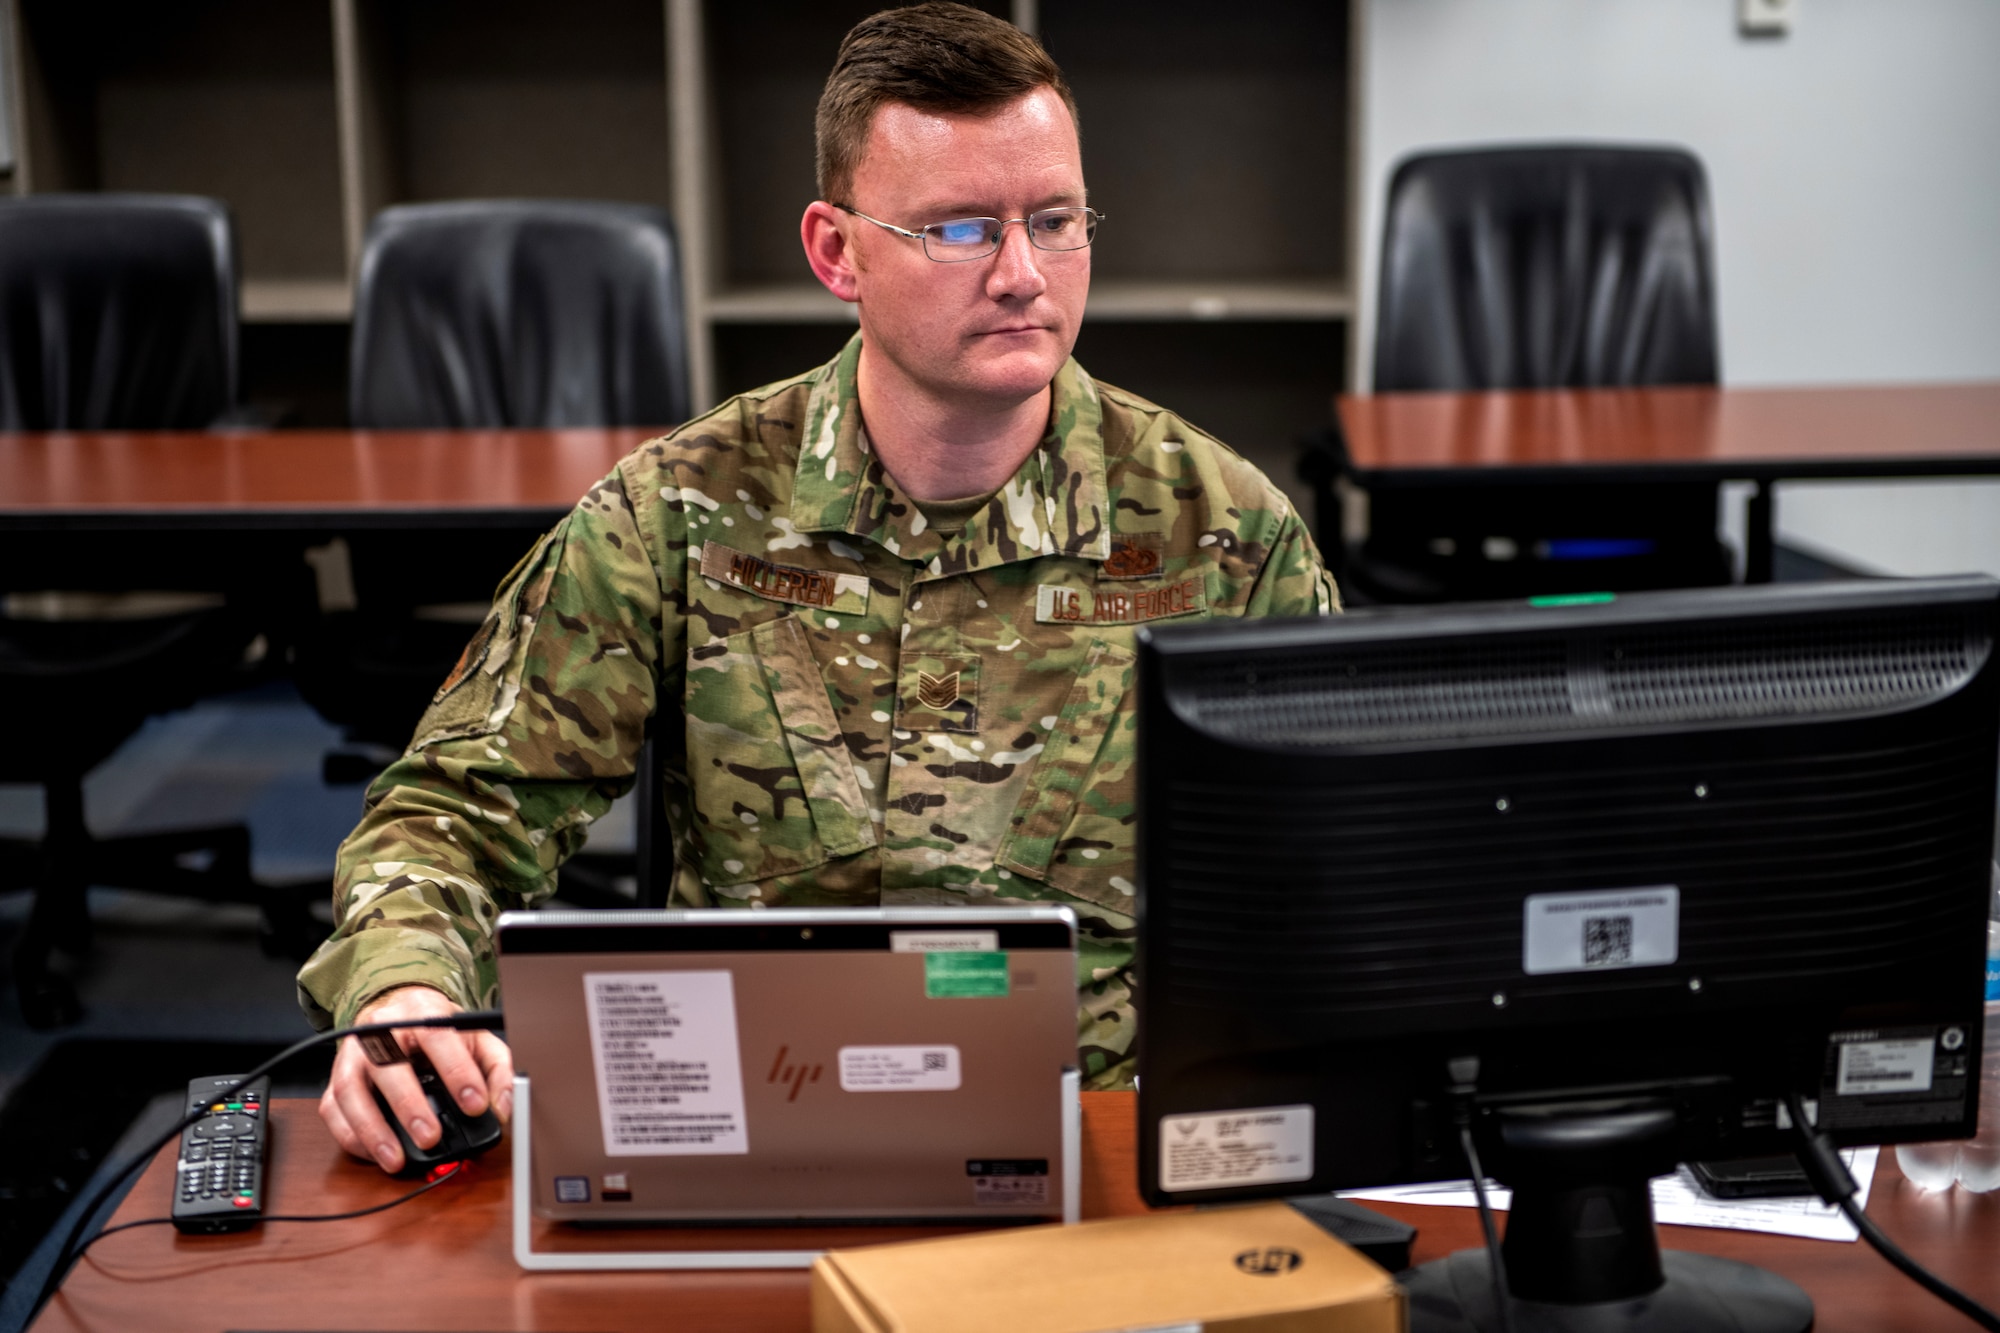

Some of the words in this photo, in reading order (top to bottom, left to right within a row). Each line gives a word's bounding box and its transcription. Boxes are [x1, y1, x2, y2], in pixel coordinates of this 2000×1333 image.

[731, 553, 836, 607] HILLEREN
[1053, 590, 1086, 621] U.S.
[1093, 593, 1128, 622] AIR
[1134, 581, 1195, 620] FORCE
[767, 1045, 823, 1102] hp
